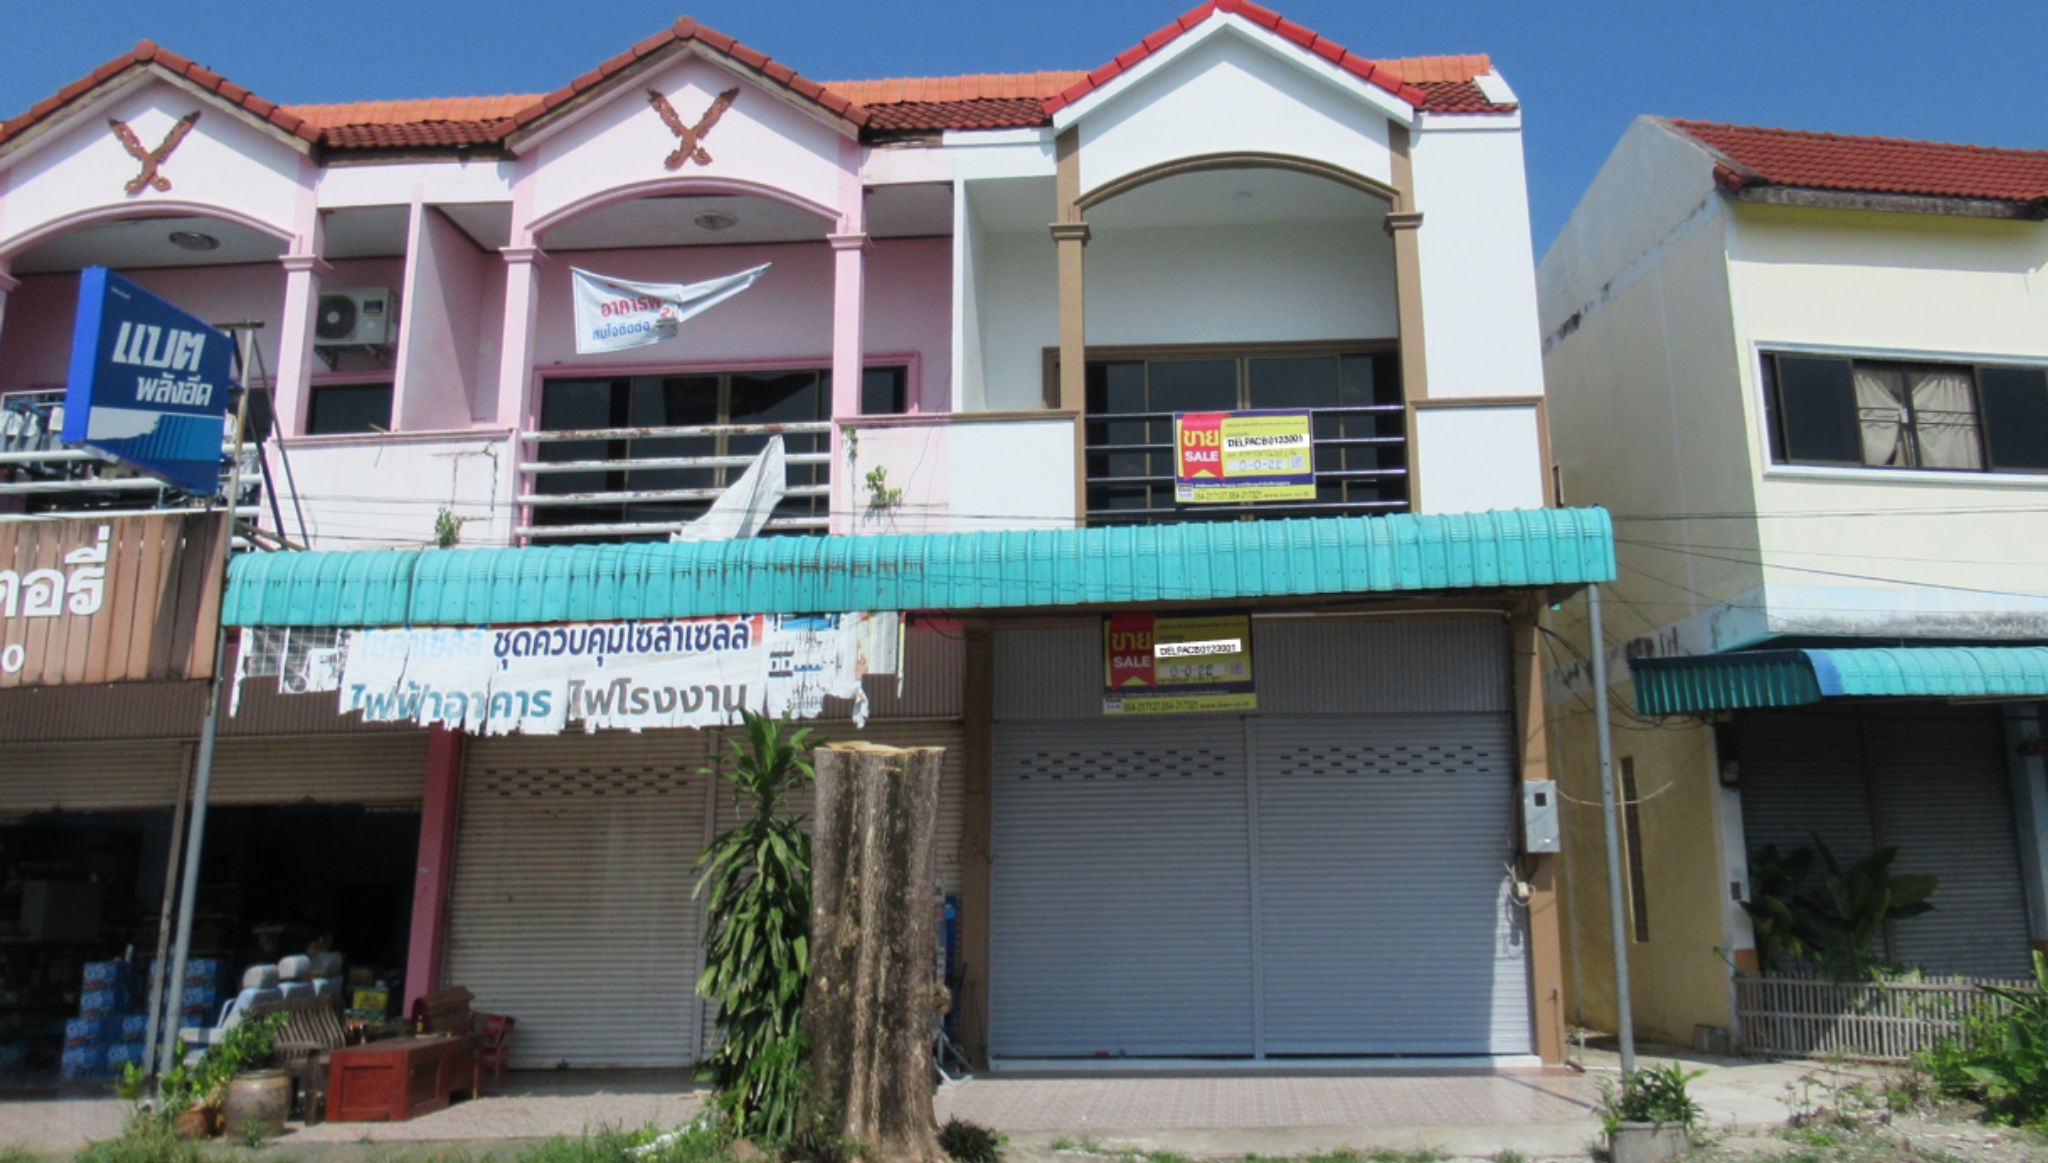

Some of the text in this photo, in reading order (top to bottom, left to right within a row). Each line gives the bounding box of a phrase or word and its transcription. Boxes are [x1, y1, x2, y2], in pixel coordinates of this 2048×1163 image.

[112, 321, 206, 372] แบต
[1183, 429, 1219, 447] ขาย
[1184, 451, 1219, 462] SALE
[1111, 631, 1150, 650] ขาย
[1113, 655, 1151, 668] SALE
[568, 677, 747, 718] ไฟโรงงาน
